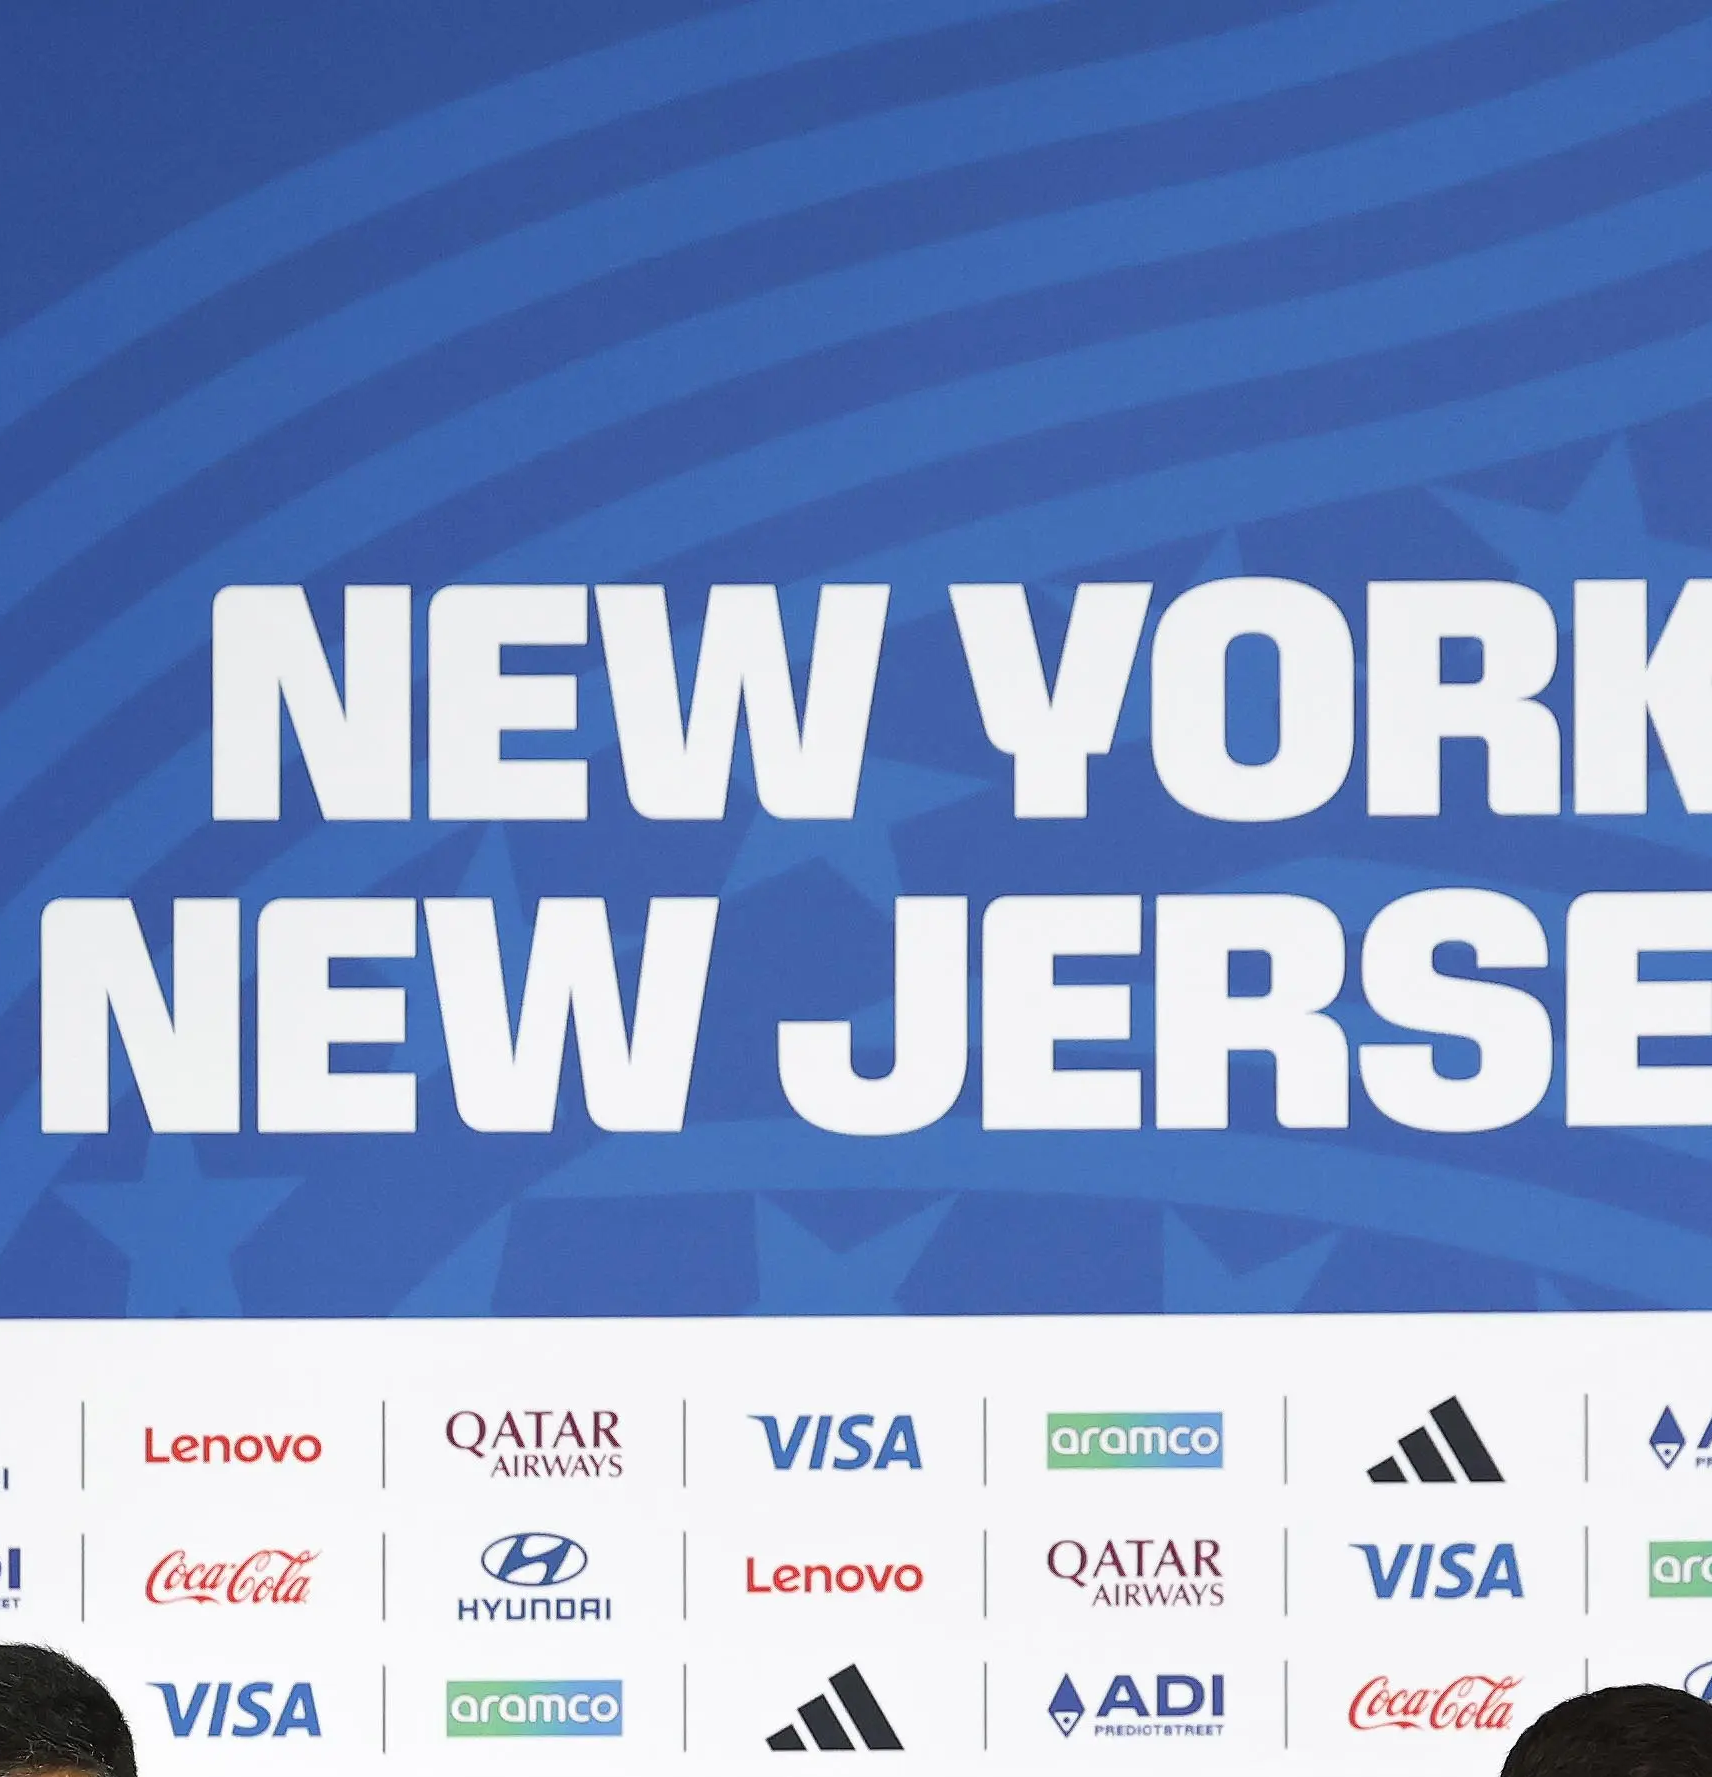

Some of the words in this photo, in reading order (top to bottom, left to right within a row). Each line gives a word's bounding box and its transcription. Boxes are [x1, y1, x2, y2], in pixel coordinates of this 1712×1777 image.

[212, 583, 891, 821] NEW
[40, 896, 720, 1134] NEW
[144, 1426, 322, 1464] Lenovo
[445, 1409, 620, 1457] QATAR
[748, 1413, 923, 1472] VISA
[1051, 1426, 1219, 1455] aramco
[491, 1454, 623, 1478] AIRWAYS
[1349, 1542, 1525, 1600] VISA
[457, 1597, 612, 1621] HYUNDAI
[451, 1694, 618, 1723] aramco
